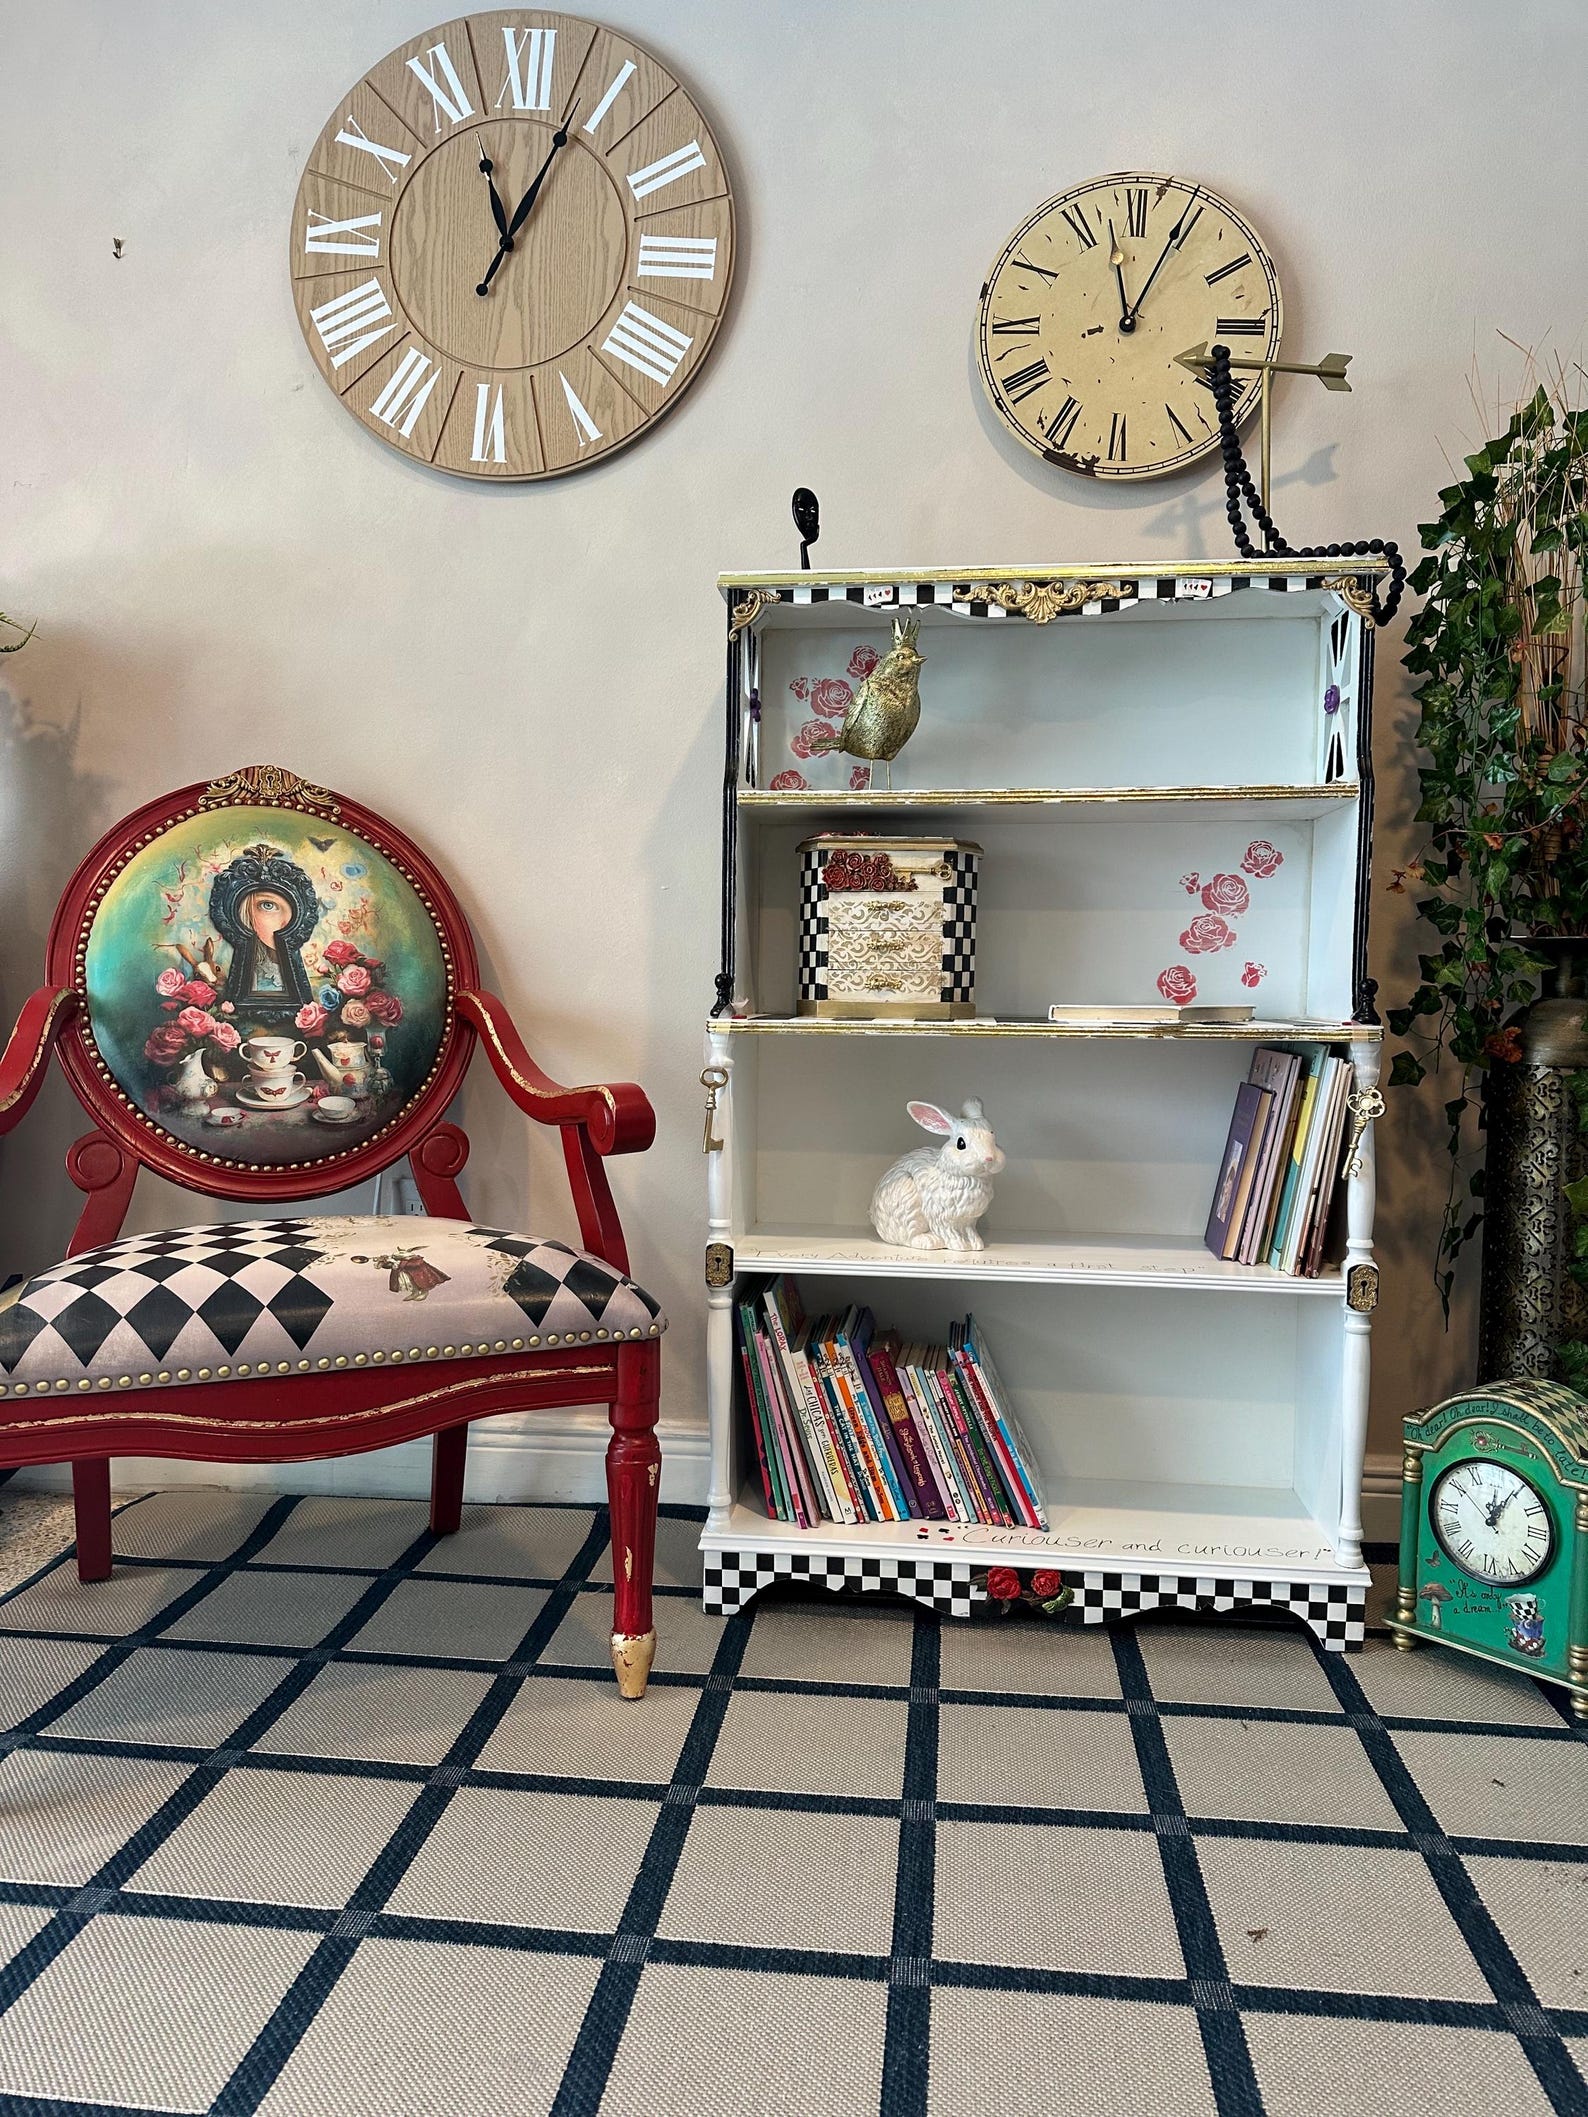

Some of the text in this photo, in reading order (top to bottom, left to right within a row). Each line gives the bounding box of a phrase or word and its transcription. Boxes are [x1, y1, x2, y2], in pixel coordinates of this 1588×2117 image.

[405, 42, 476, 133] XI
[495, 27, 557, 110] XII
[583, 59, 637, 134] I
[334, 115, 412, 184] X
[626, 139, 707, 201] II
[305, 208, 382, 258] IX
[1059, 202, 1099, 255] XI
[1121, 188, 1149, 238] XII
[1171, 205, 1206, 253] I
[637, 233, 717, 280] III
[1010, 248, 1060, 289] X
[1204, 252, 1253, 288] II
[310, 277, 398, 371] VIII
[992, 313, 1040, 336] IX
[1215, 318, 1266, 338] III
[369, 346, 442, 439] VII
[1000, 356, 1053, 407] VIII
[470, 383, 507, 463] VI
[559, 370, 603, 447] V
[1043, 395, 1084, 450] VII
[1165, 403, 1196, 449] V
[1106, 412, 1128, 461] VI
[768, 1312, 779, 1327] The
[773, 1326, 788, 1352] LORAX
[801, 1418, 816, 1440] Seuss
[833, 1403, 842, 1416] THE
[837, 1417, 847, 1431] CAT
[1425, 1413, 1448, 1437] dear!
[1450, 1408, 1463, 1421] Oh
[1465, 1402, 1490, 1416] dear!
[1501, 1405, 1529, 1425] shall
[1531, 1420, 1545, 1436] be
[806, 1394, 826, 1428] CHICAS
[820, 1438, 839, 1475] GUERRERAS
[845, 1440, 854, 1452] THE
[846, 1406, 859, 1428] Green
[855, 1430, 867, 1449] Eggs
[862, 1449, 872, 1464] and
[867, 1465, 878, 1482] Ham
[850, 1452, 859, 1467] HAT
[911, 1462, 927, 1488] Legends
[1121, 1539, 1162, 1552] and
[1453, 1606, 1460, 1615] a
